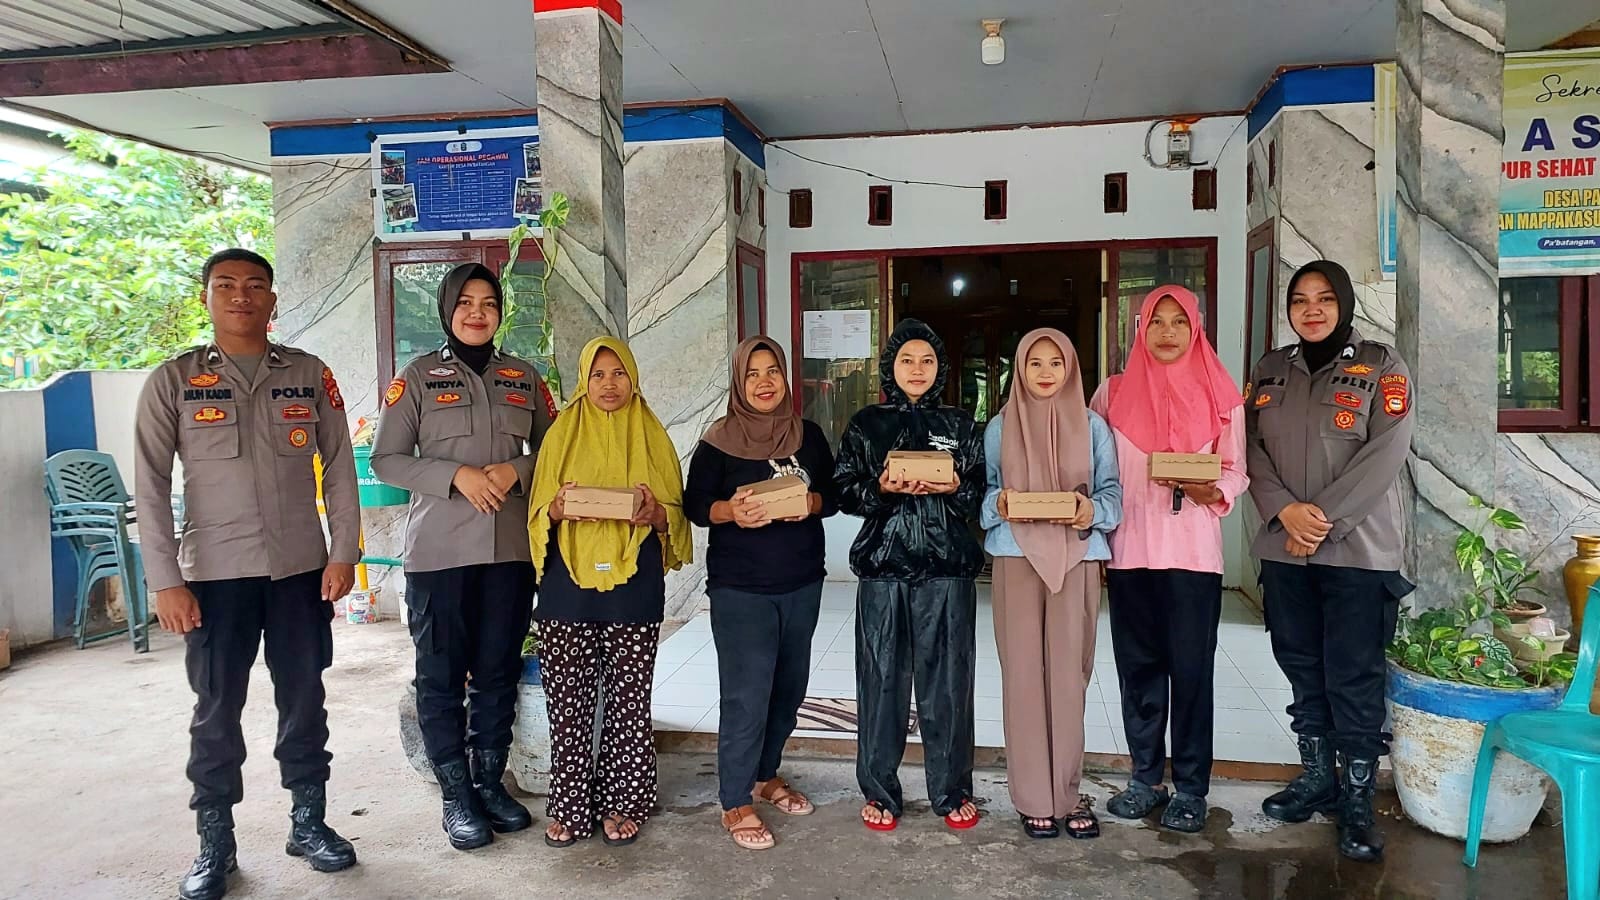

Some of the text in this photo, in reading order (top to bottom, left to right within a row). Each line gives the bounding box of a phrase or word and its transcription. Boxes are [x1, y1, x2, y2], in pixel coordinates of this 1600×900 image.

[432, 155, 477, 164] OPERASIONAL
[1537, 157, 1597, 178] SEHAT
[1544, 188, 1581, 208] DESA
[1543, 237, 1597, 247] Pa'batangan,
[425, 379, 465, 390] WIDYA
[494, 379, 532, 392] POLRI
[1331, 376, 1375, 393] POLRI
[271, 387, 315, 400] POLRI
